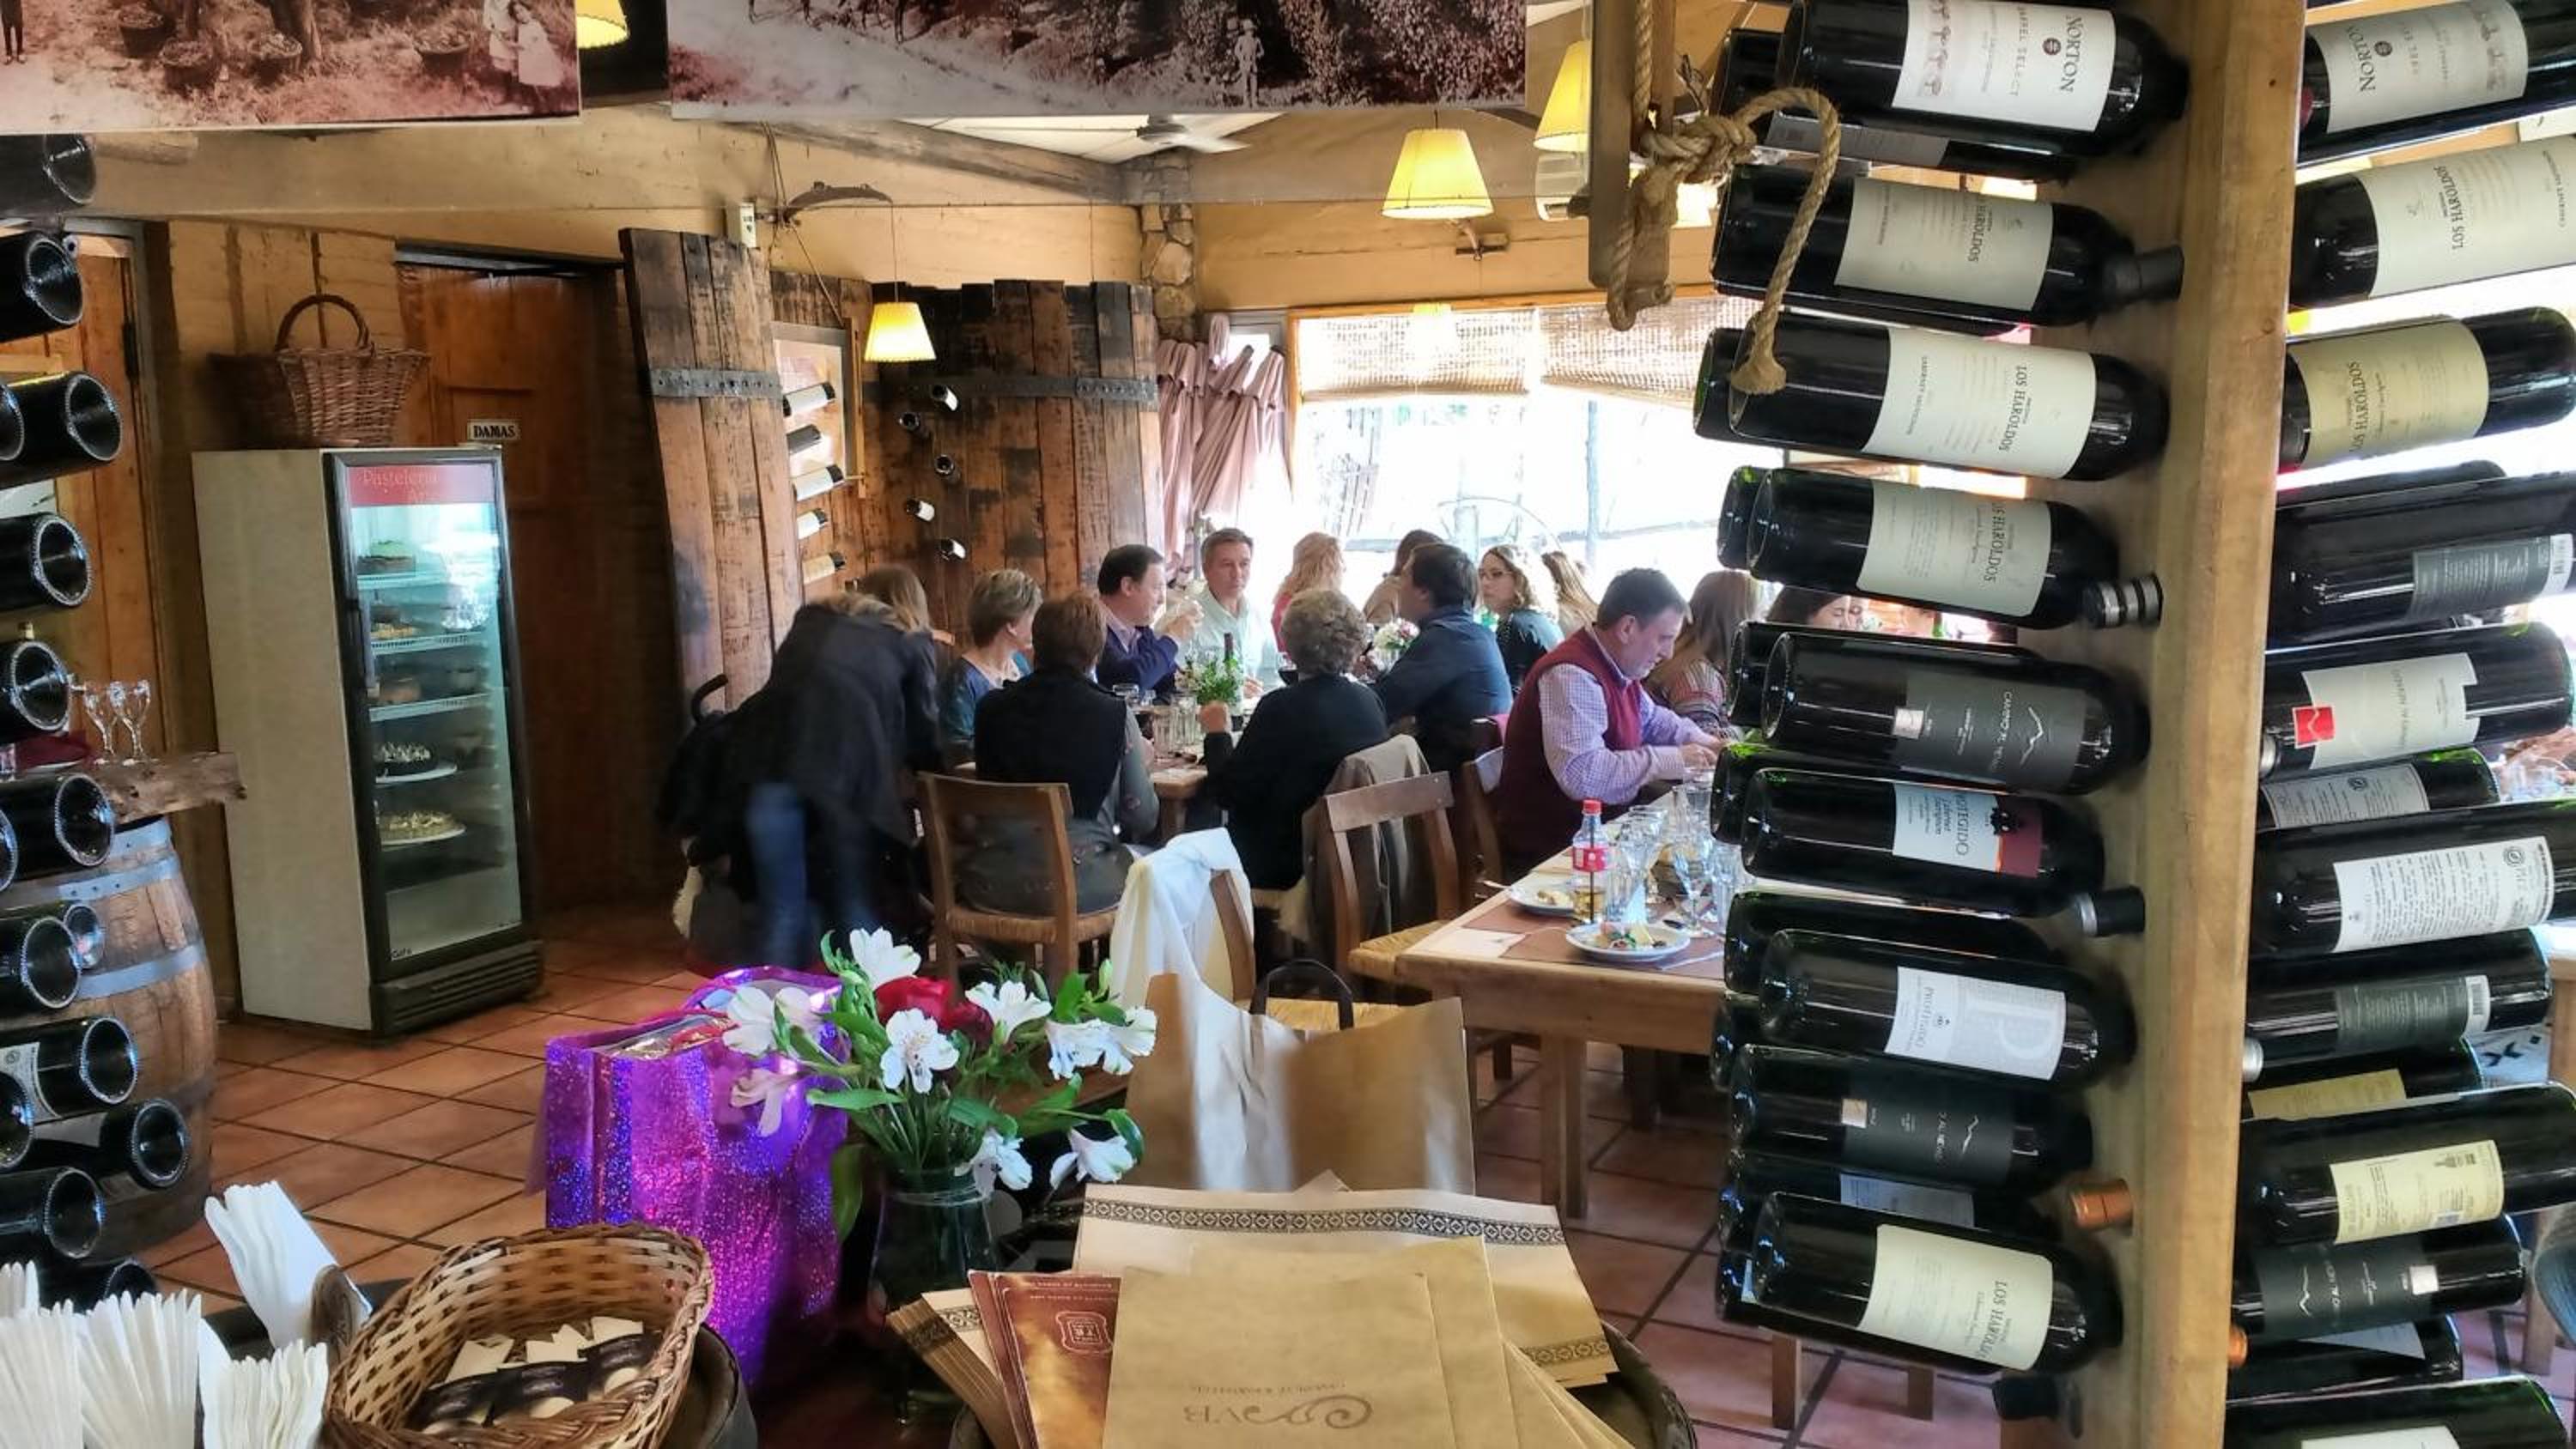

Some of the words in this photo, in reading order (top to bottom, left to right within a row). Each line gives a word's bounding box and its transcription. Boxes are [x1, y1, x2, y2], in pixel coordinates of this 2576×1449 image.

[2060, 13, 2082, 93] NORTON
[2345, 24, 2376, 92] NORTON
[2433, 165, 2465, 223] HAROLDOS
[2451, 226, 2465, 250] LOS
[2016, 364, 2027, 388] LOS
[2347, 361, 2370, 433] HAROLDOS
[473, 425, 516, 439] DAMAS
[1998, 391, 2026, 452] HAROLDOS
[1984, 516, 2006, 583] HAROLDOS
[1995, 1281, 2009, 1305] LOS
